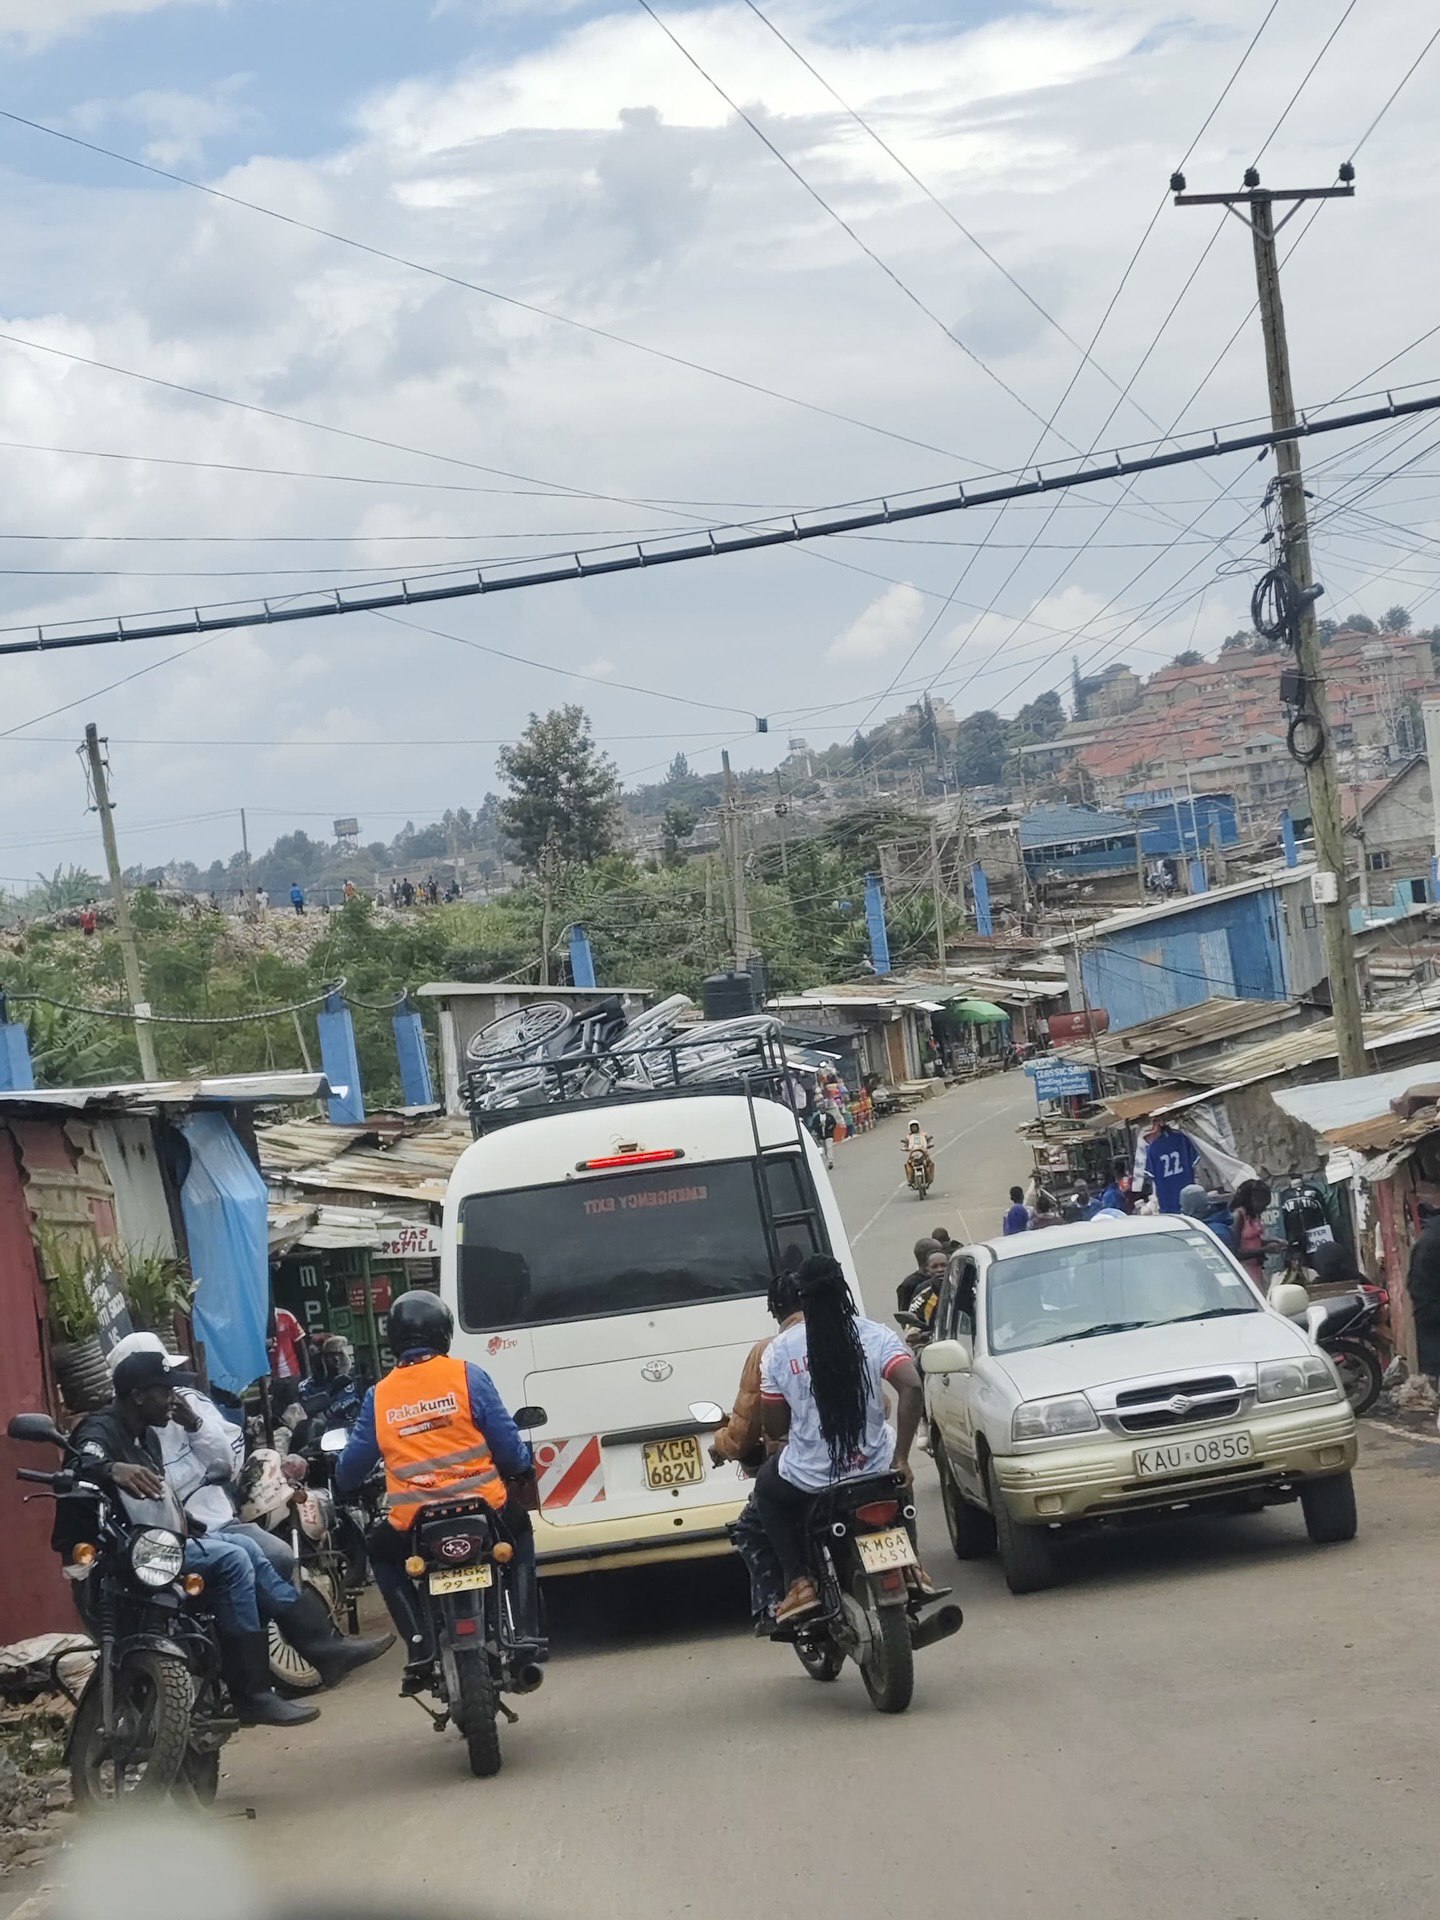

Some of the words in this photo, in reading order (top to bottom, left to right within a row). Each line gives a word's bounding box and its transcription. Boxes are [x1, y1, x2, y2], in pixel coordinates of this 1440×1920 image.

[1160, 1151, 1183, 1178] 22
[399, 1228, 428, 1241] GAS
[382, 1240, 437, 1254] REFILL
[387, 1394, 456, 1422] Pakakumi
[656, 1440, 696, 1463] KCQ
[1138, 1447, 1181, 1474] KAU
[1194, 1436, 1250, 1463] 085G
[651, 1460, 695, 1485] 682V
[861, 1533, 905, 1553] KMGA
